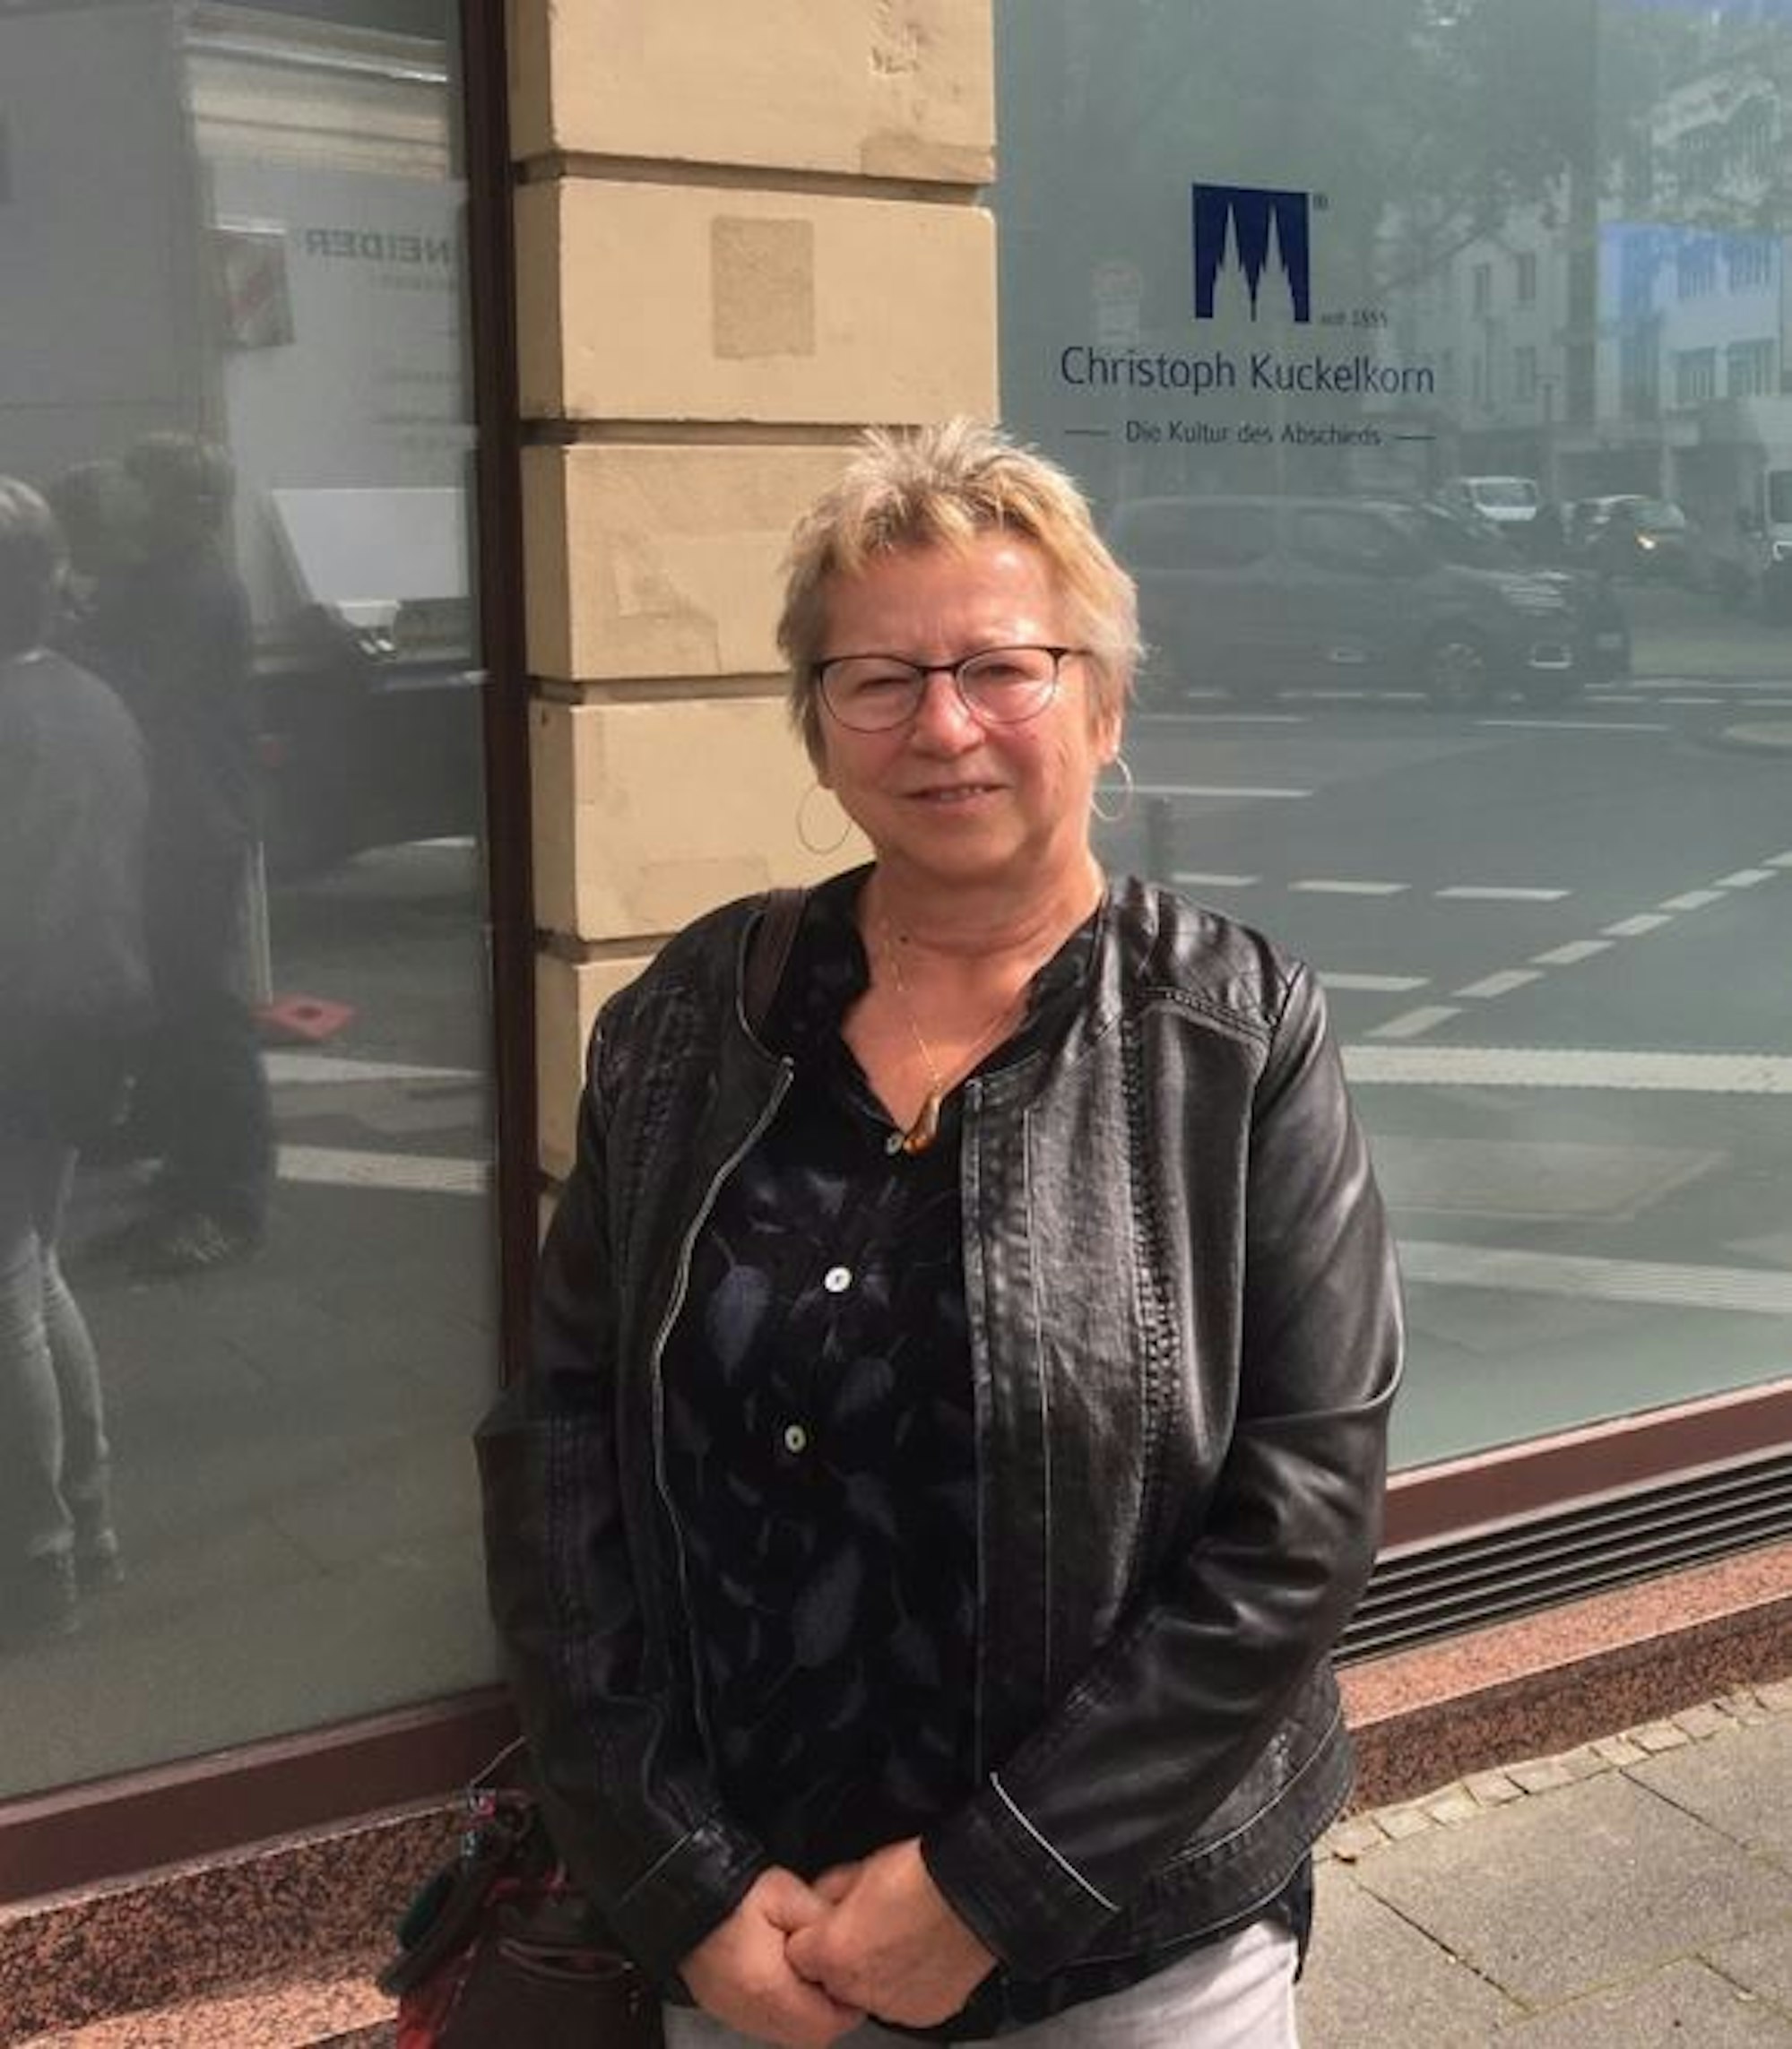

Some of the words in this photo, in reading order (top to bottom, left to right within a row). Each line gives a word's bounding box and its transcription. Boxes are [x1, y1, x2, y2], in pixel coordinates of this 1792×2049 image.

[1060, 346, 1236, 395] Christoph
[1251, 354, 1435, 393] Kuckelkorn
[1126, 420, 1162, 443] Die
[1169, 420, 1229, 444] Kultur
[1237, 422, 1274, 444] des
[1281, 424, 1381, 446] Abschieds
